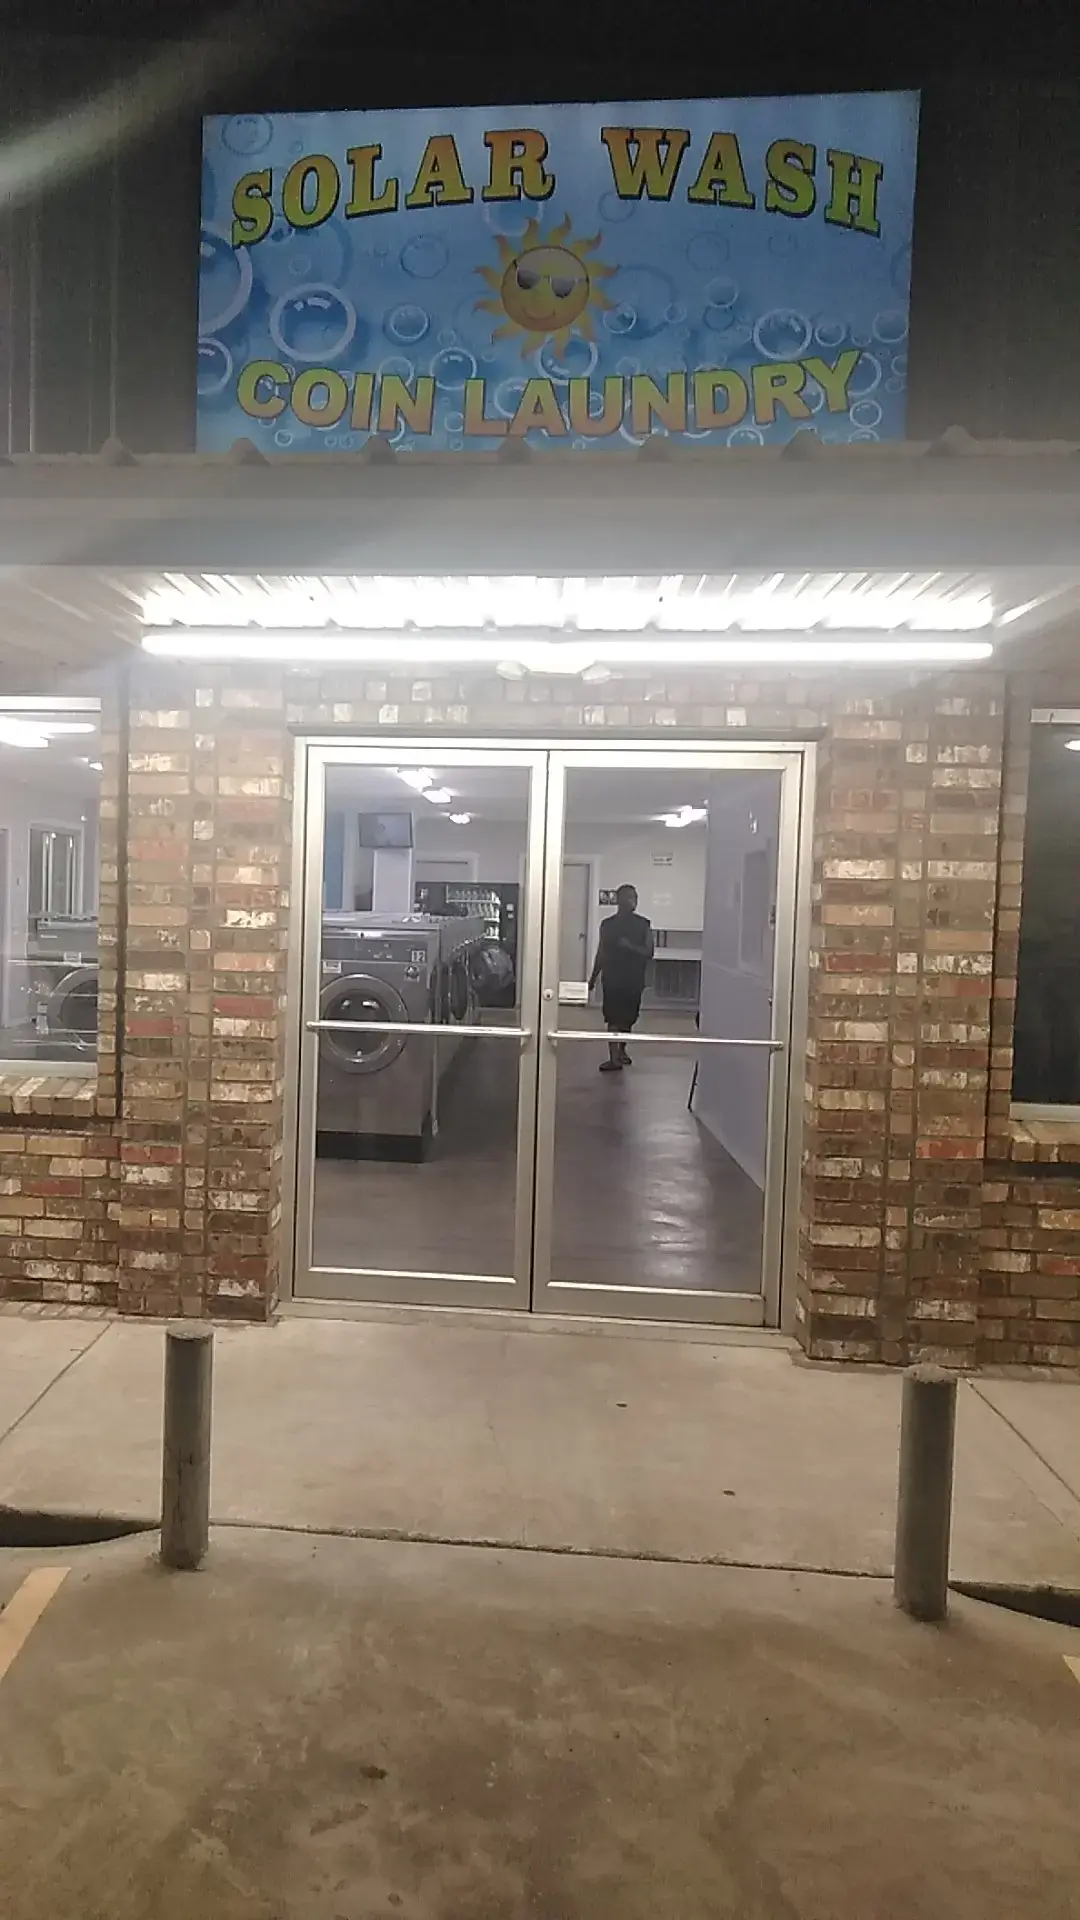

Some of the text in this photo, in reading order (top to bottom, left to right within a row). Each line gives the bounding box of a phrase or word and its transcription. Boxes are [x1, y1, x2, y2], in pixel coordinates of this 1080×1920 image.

[231, 127, 884, 249] SOLAR WASH
[237, 350, 862, 438] COIN LAUNDRY
